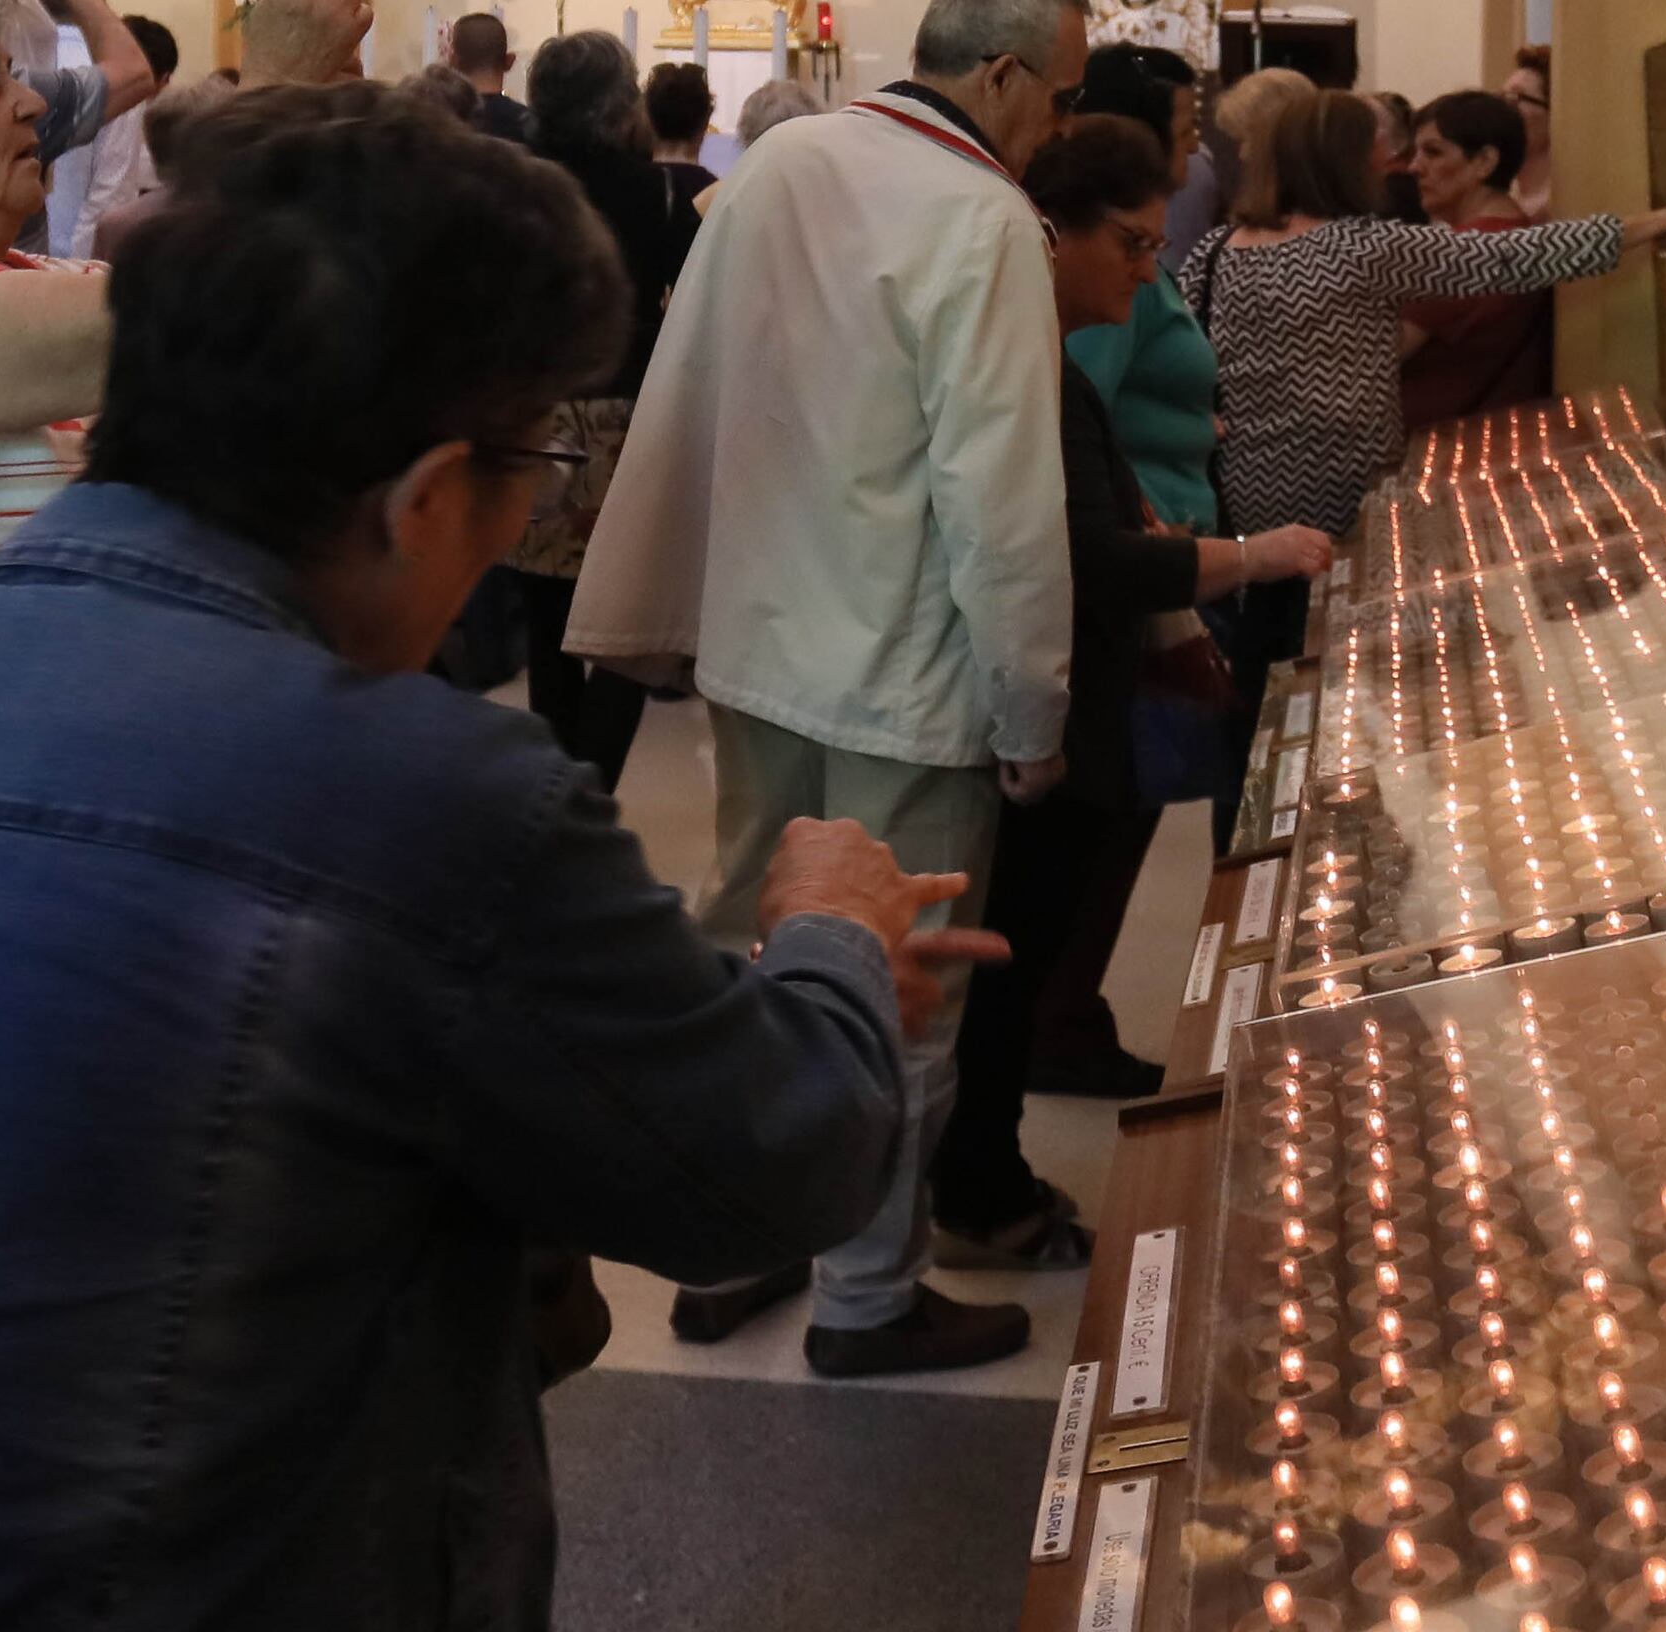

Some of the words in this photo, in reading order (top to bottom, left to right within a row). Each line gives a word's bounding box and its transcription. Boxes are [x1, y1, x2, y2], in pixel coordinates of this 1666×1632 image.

[1136, 1265, 1161, 1312] OFRENDA
[1134, 1314, 1156, 1327] 15
[1071, 1375, 1088, 1395] QUE
[1069, 1397, 1083, 1409] MI
[1065, 1410, 1081, 1431] LUZ
[1060, 1433, 1076, 1454] SEA
[1056, 1456, 1072, 1478] UNA
[1044, 1481, 1068, 1541] PLEGARIA
[1104, 1531, 1132, 1553] Use
[1092, 1578, 1119, 1628] monedas
